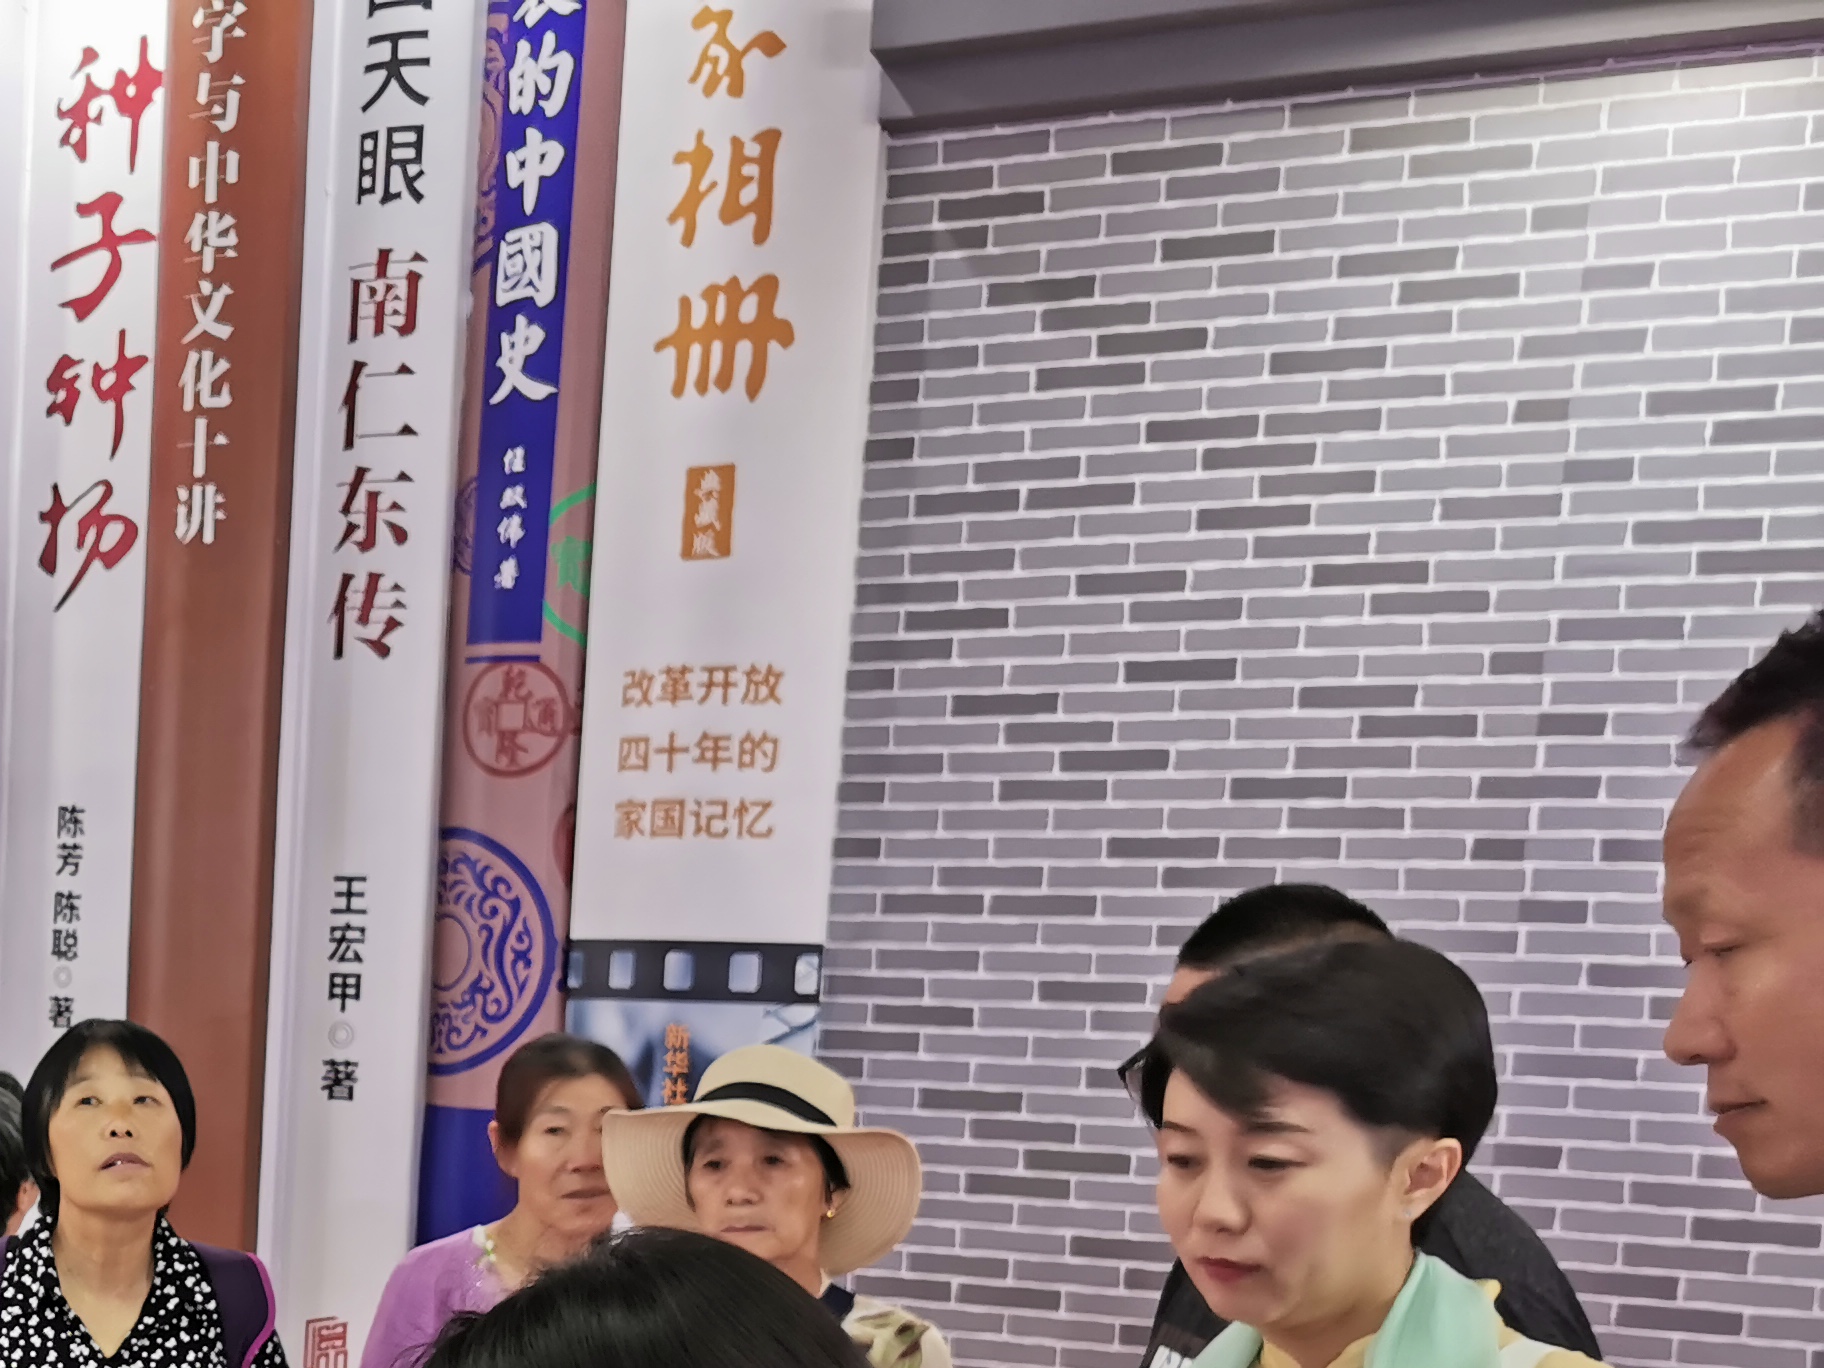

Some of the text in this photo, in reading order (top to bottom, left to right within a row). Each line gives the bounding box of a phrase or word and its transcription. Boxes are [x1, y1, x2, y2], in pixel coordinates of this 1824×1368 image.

[327, 0, 433, 660] 天眼 南仁东传
[620, 664, 785, 708] 改革开放
[616, 730, 780, 774] 四十年的
[614, 797, 775, 842] 家国记忆
[320, 874, 370, 1102] 王宏甲 著
